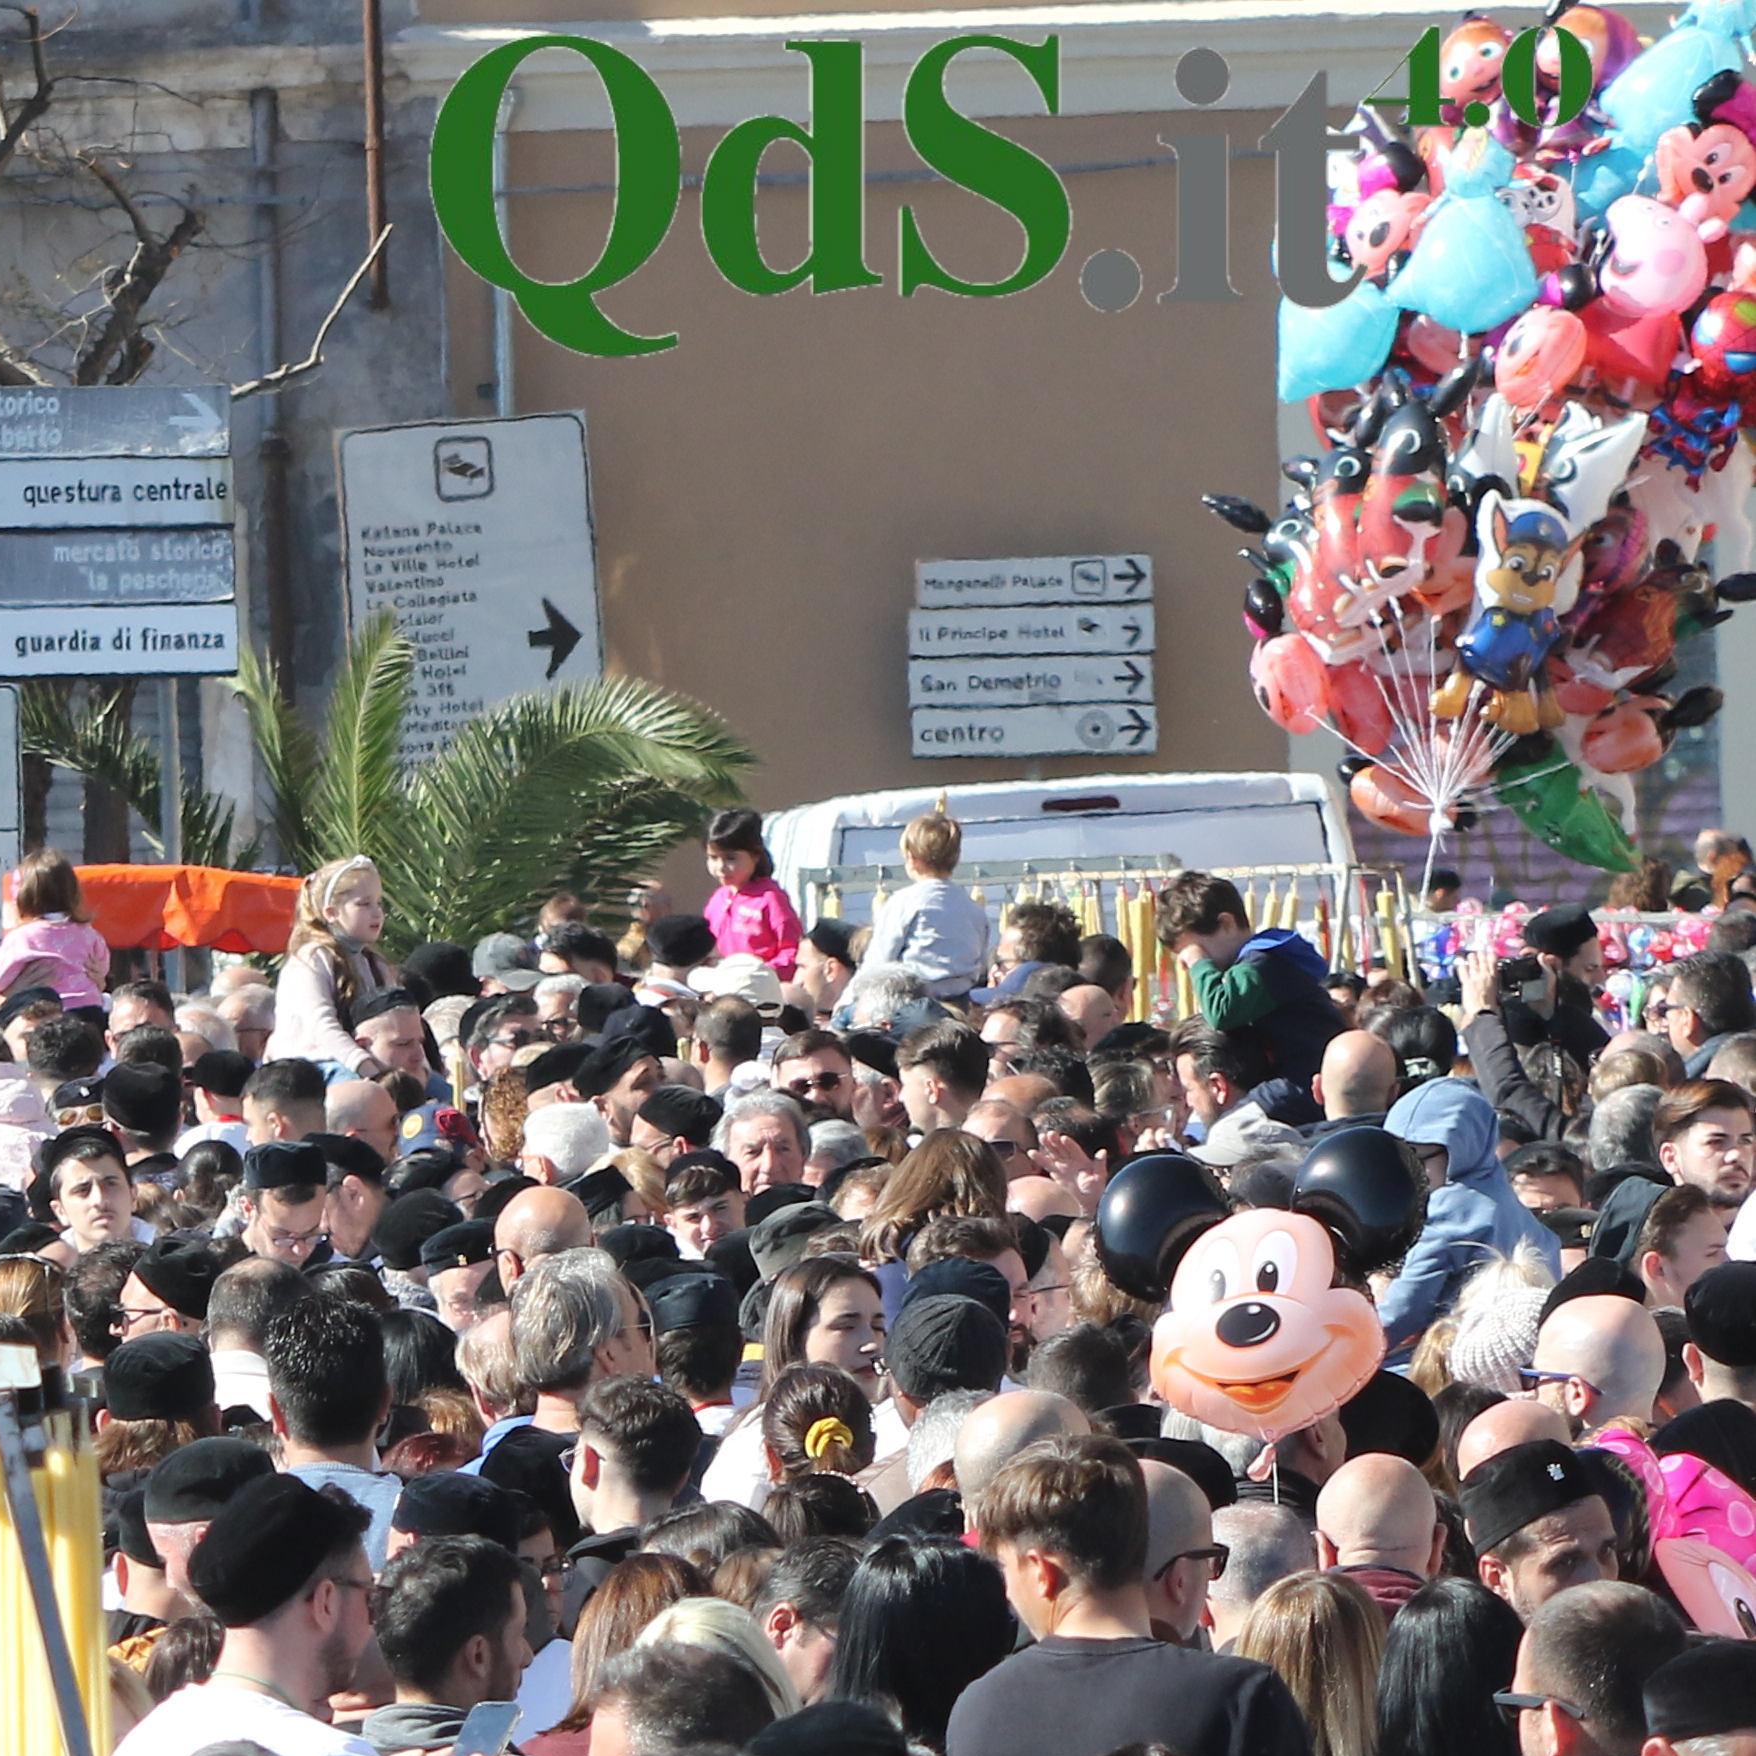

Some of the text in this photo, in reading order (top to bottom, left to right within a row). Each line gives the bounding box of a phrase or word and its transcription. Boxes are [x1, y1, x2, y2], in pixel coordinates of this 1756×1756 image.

[23, 477, 228, 508] questura centrale
[427, 521, 482, 536] Palace
[54, 536, 225, 562] mercato storico
[436, 553, 480, 569] Hotel
[15, 626, 225, 658] guardia di finanza
[937, 627, 1008, 641] Principe
[1018, 626, 1065, 639] Hotel
[422, 665, 466, 679] Hotel
[920, 673, 1062, 692] San Demetrio
[440, 698, 484, 713] Hotel
[921, 722, 1005, 744] centro
